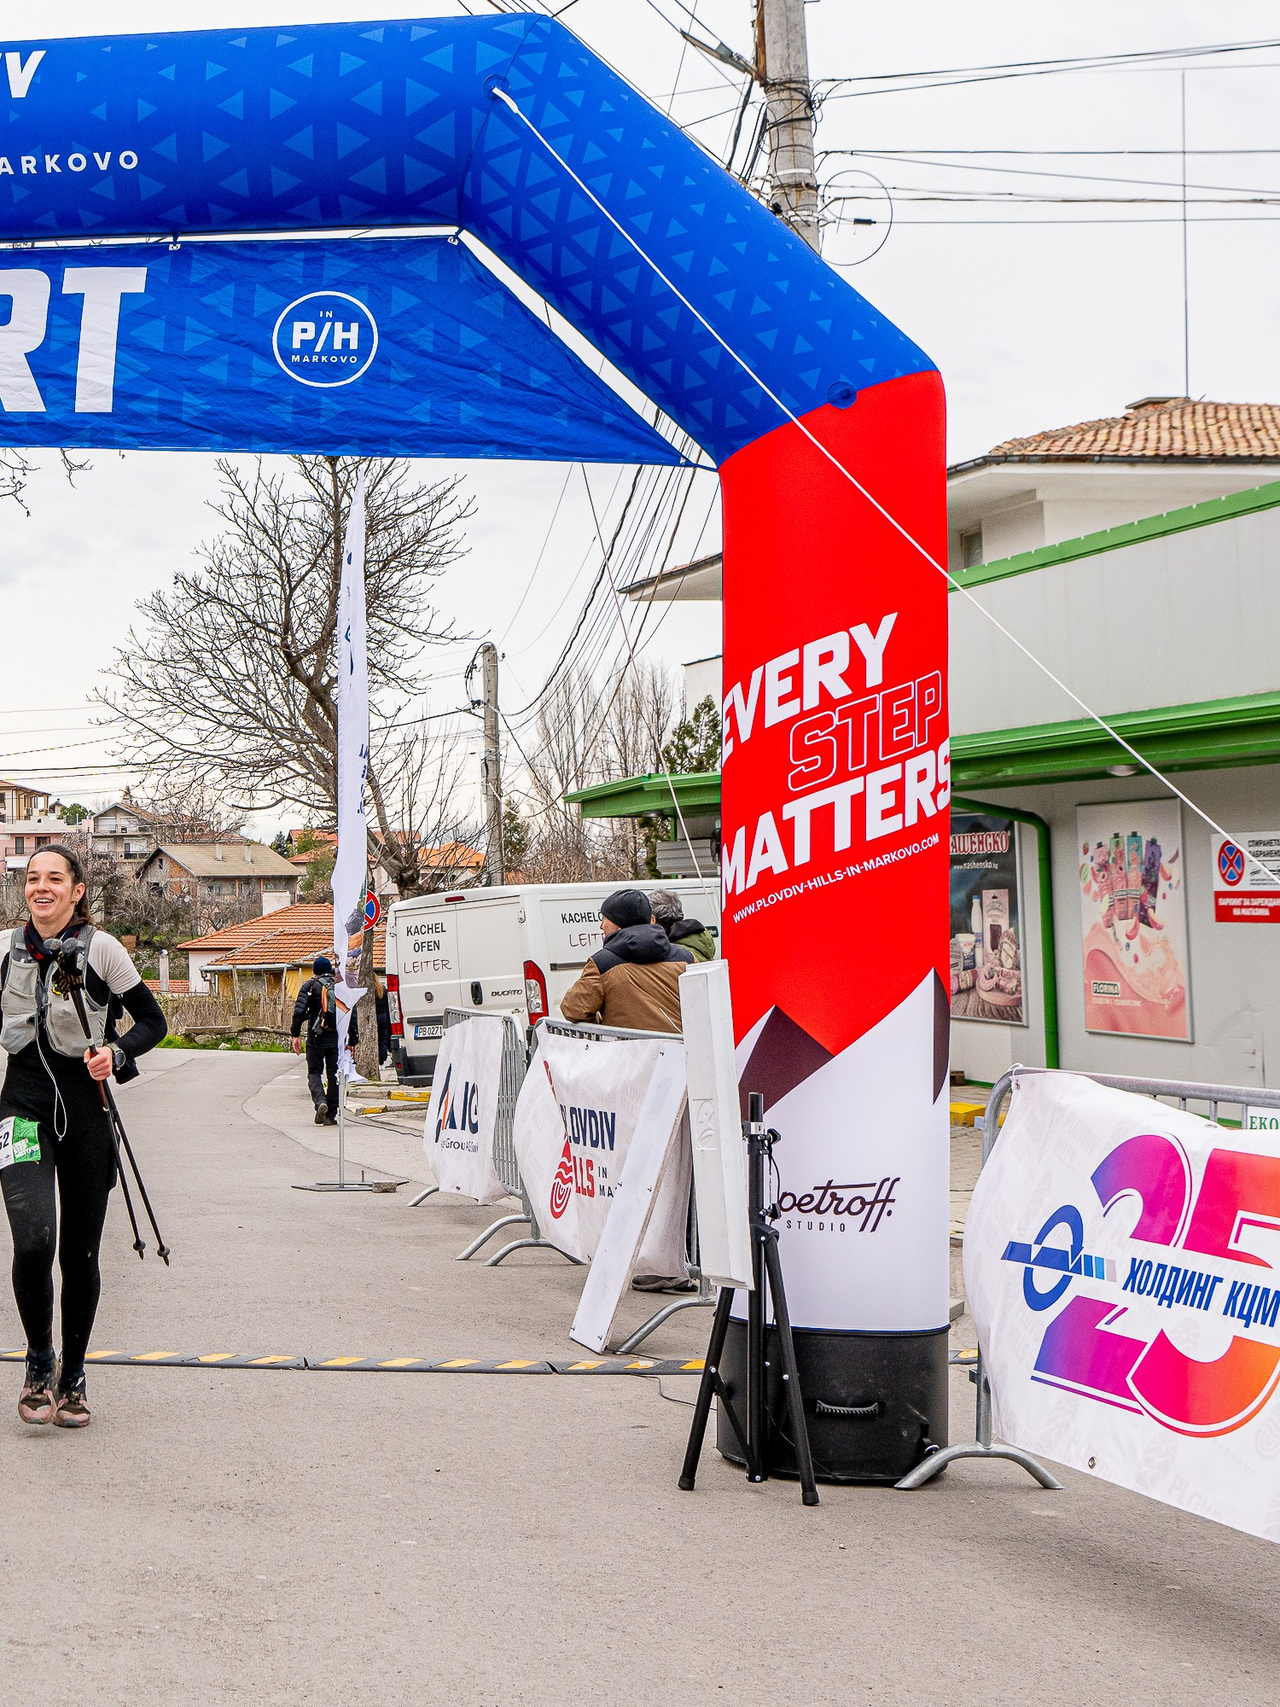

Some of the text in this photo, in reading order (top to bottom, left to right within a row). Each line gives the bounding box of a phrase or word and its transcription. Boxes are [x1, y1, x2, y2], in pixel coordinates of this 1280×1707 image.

[319, 310, 333, 318] IN
[292, 321, 359, 352] P/H
[291, 355, 358, 363] MARKOVO
[721, 612, 898, 768] EVERY
[788, 670, 941, 792] STEP
[721, 737, 950, 912] MATTERS
[950, 831, 1009, 854] АШЕНСКО
[733, 832, 940, 923] WWW.PLOVDIV-HILLS-IN-MARKOVO.COM
[406, 922, 447, 937] KACHEL
[413, 939, 440, 953] ÖFEN
[569, 932, 605, 947] LEIT
[403, 958, 452, 974] LEITER
[491, 989, 523, 997] DUCATO
[560, 1103, 616, 1151] OVDIV
[598, 1166, 608, 1179] IN
[786, 1219, 846, 1233] STUDIO
[1122, 1257, 1280, 1329] ХОЛДИНГ КЦМ
